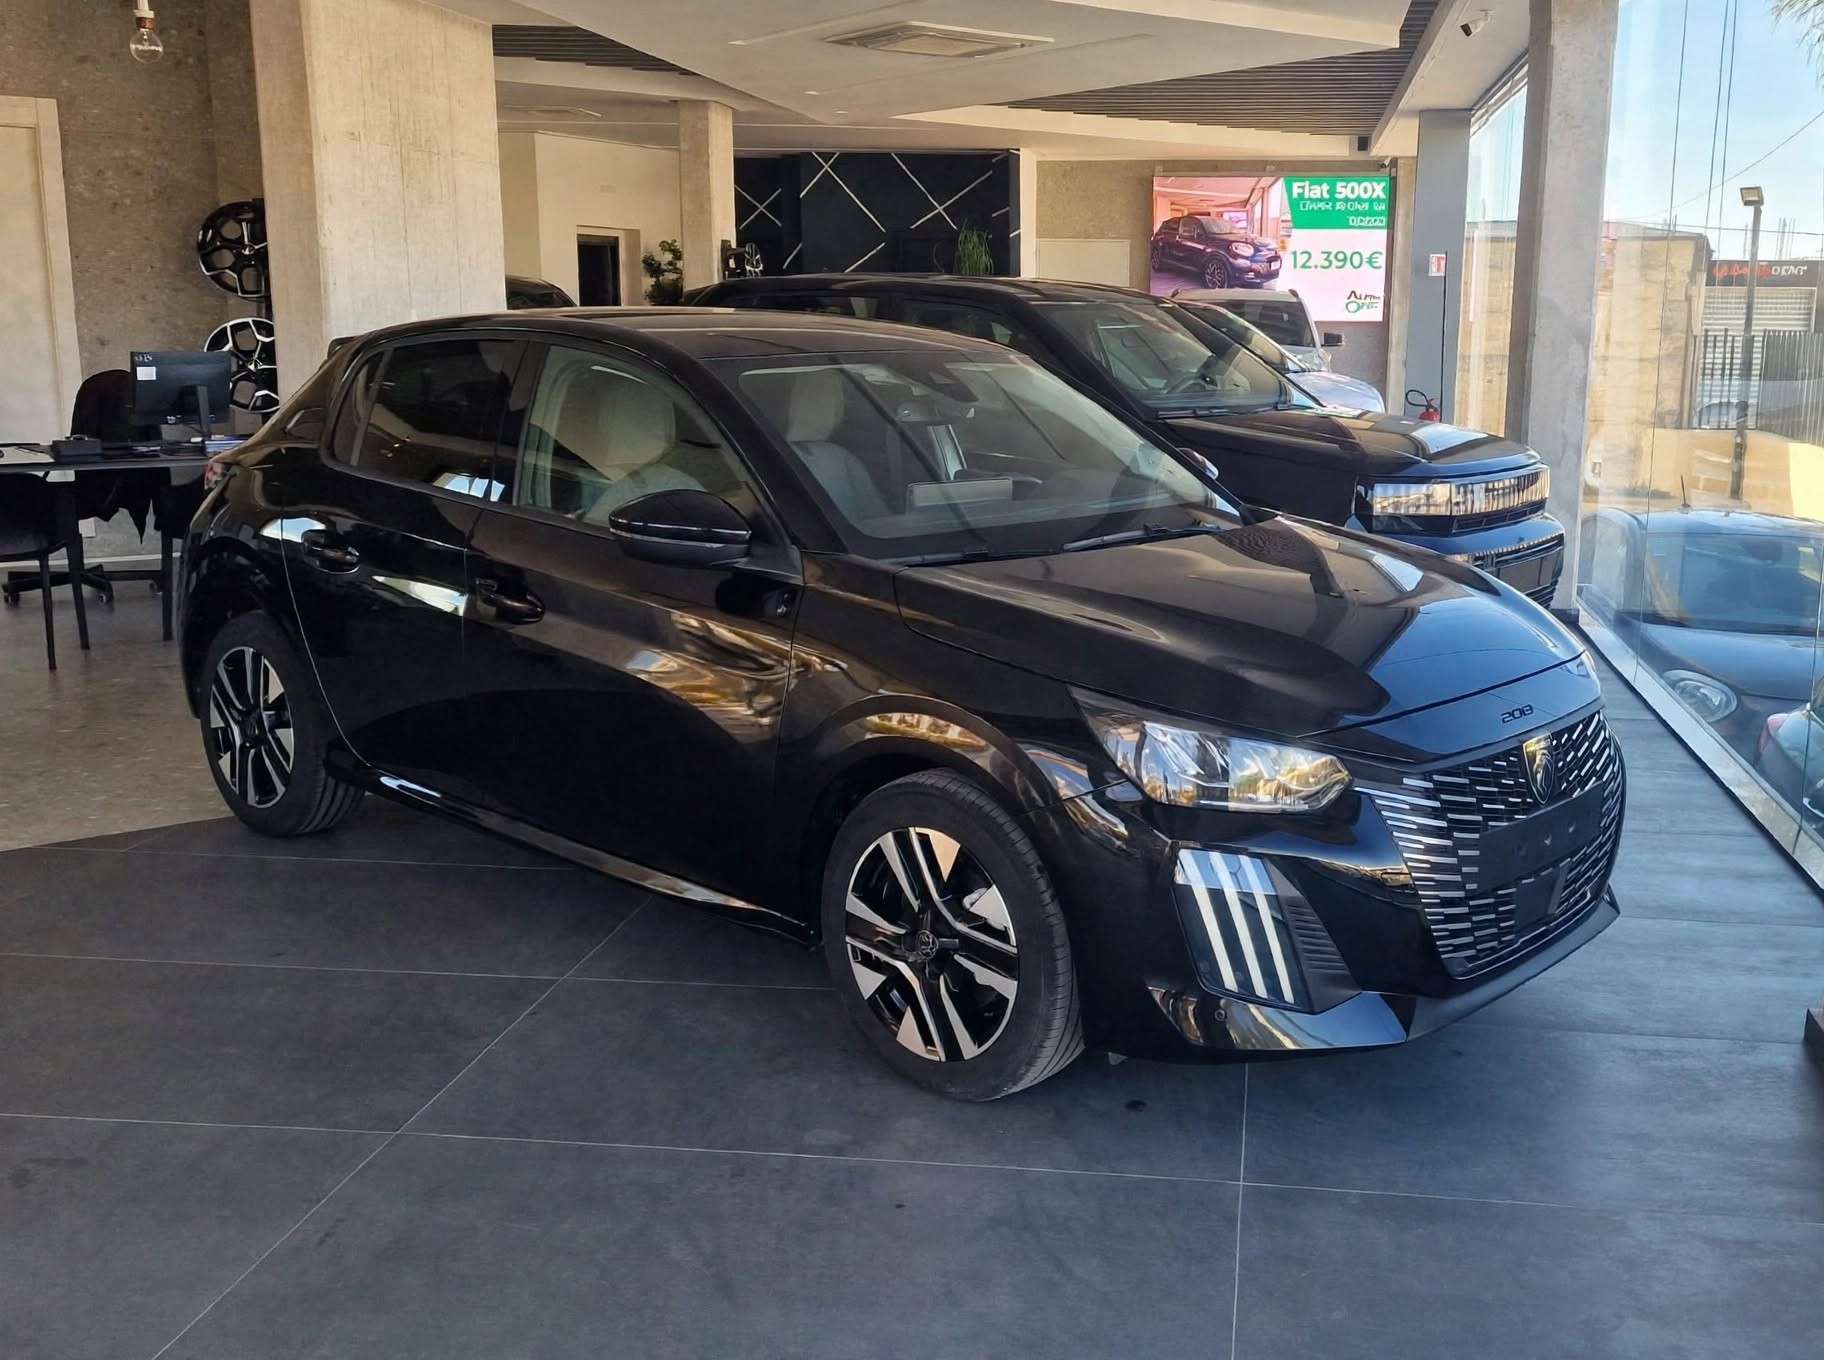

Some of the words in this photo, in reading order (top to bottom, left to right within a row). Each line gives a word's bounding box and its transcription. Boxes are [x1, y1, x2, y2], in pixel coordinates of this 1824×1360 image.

[1292, 181, 1330, 199] Fiat
[1335, 181, 1386, 199] 500X
[1291, 250, 1384, 270] 12.390€
[1500, 704, 1534, 723] 208
